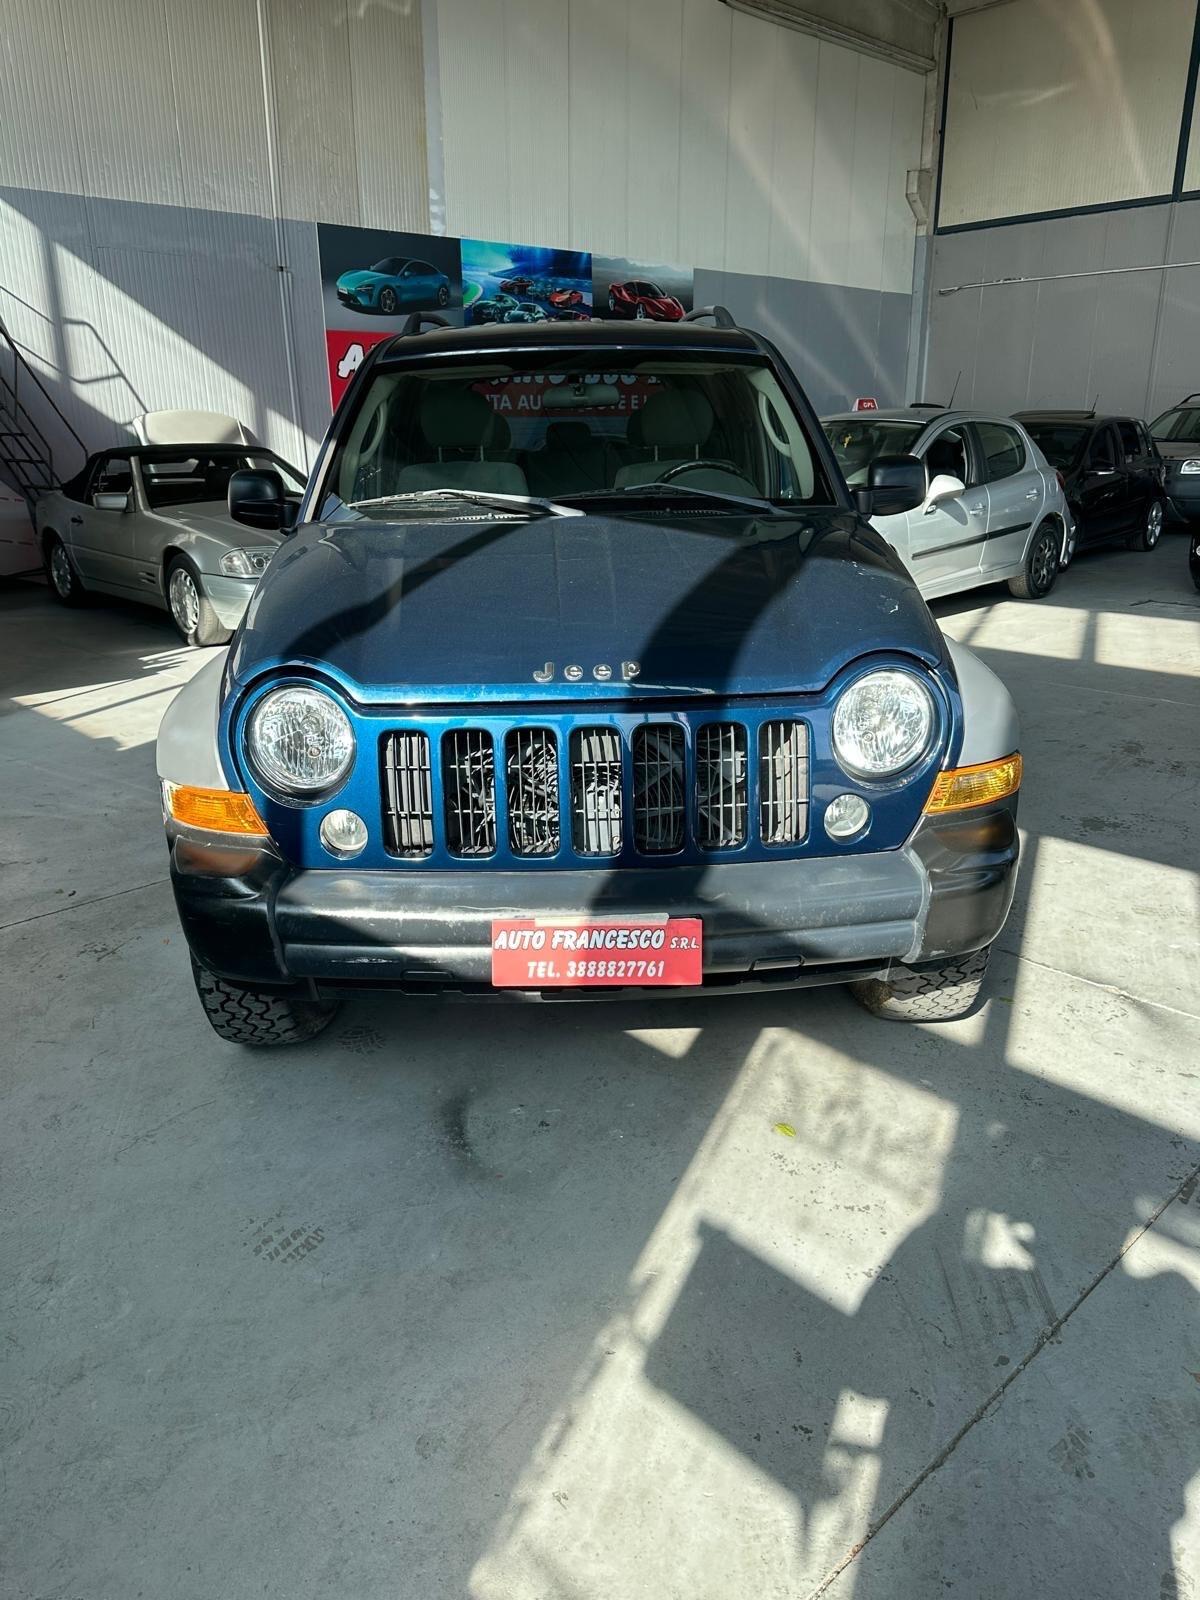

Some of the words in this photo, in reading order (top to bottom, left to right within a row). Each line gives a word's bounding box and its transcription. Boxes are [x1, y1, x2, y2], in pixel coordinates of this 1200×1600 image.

[532, 661, 641, 683] Jeep
[493, 929, 546, 950] AUTO
[550, 929, 666, 951] FRANCESCO
[670, 937, 700, 949] S.R.L.
[527, 961, 561, 978] TEL.
[566, 960, 666, 978] 3888827761
